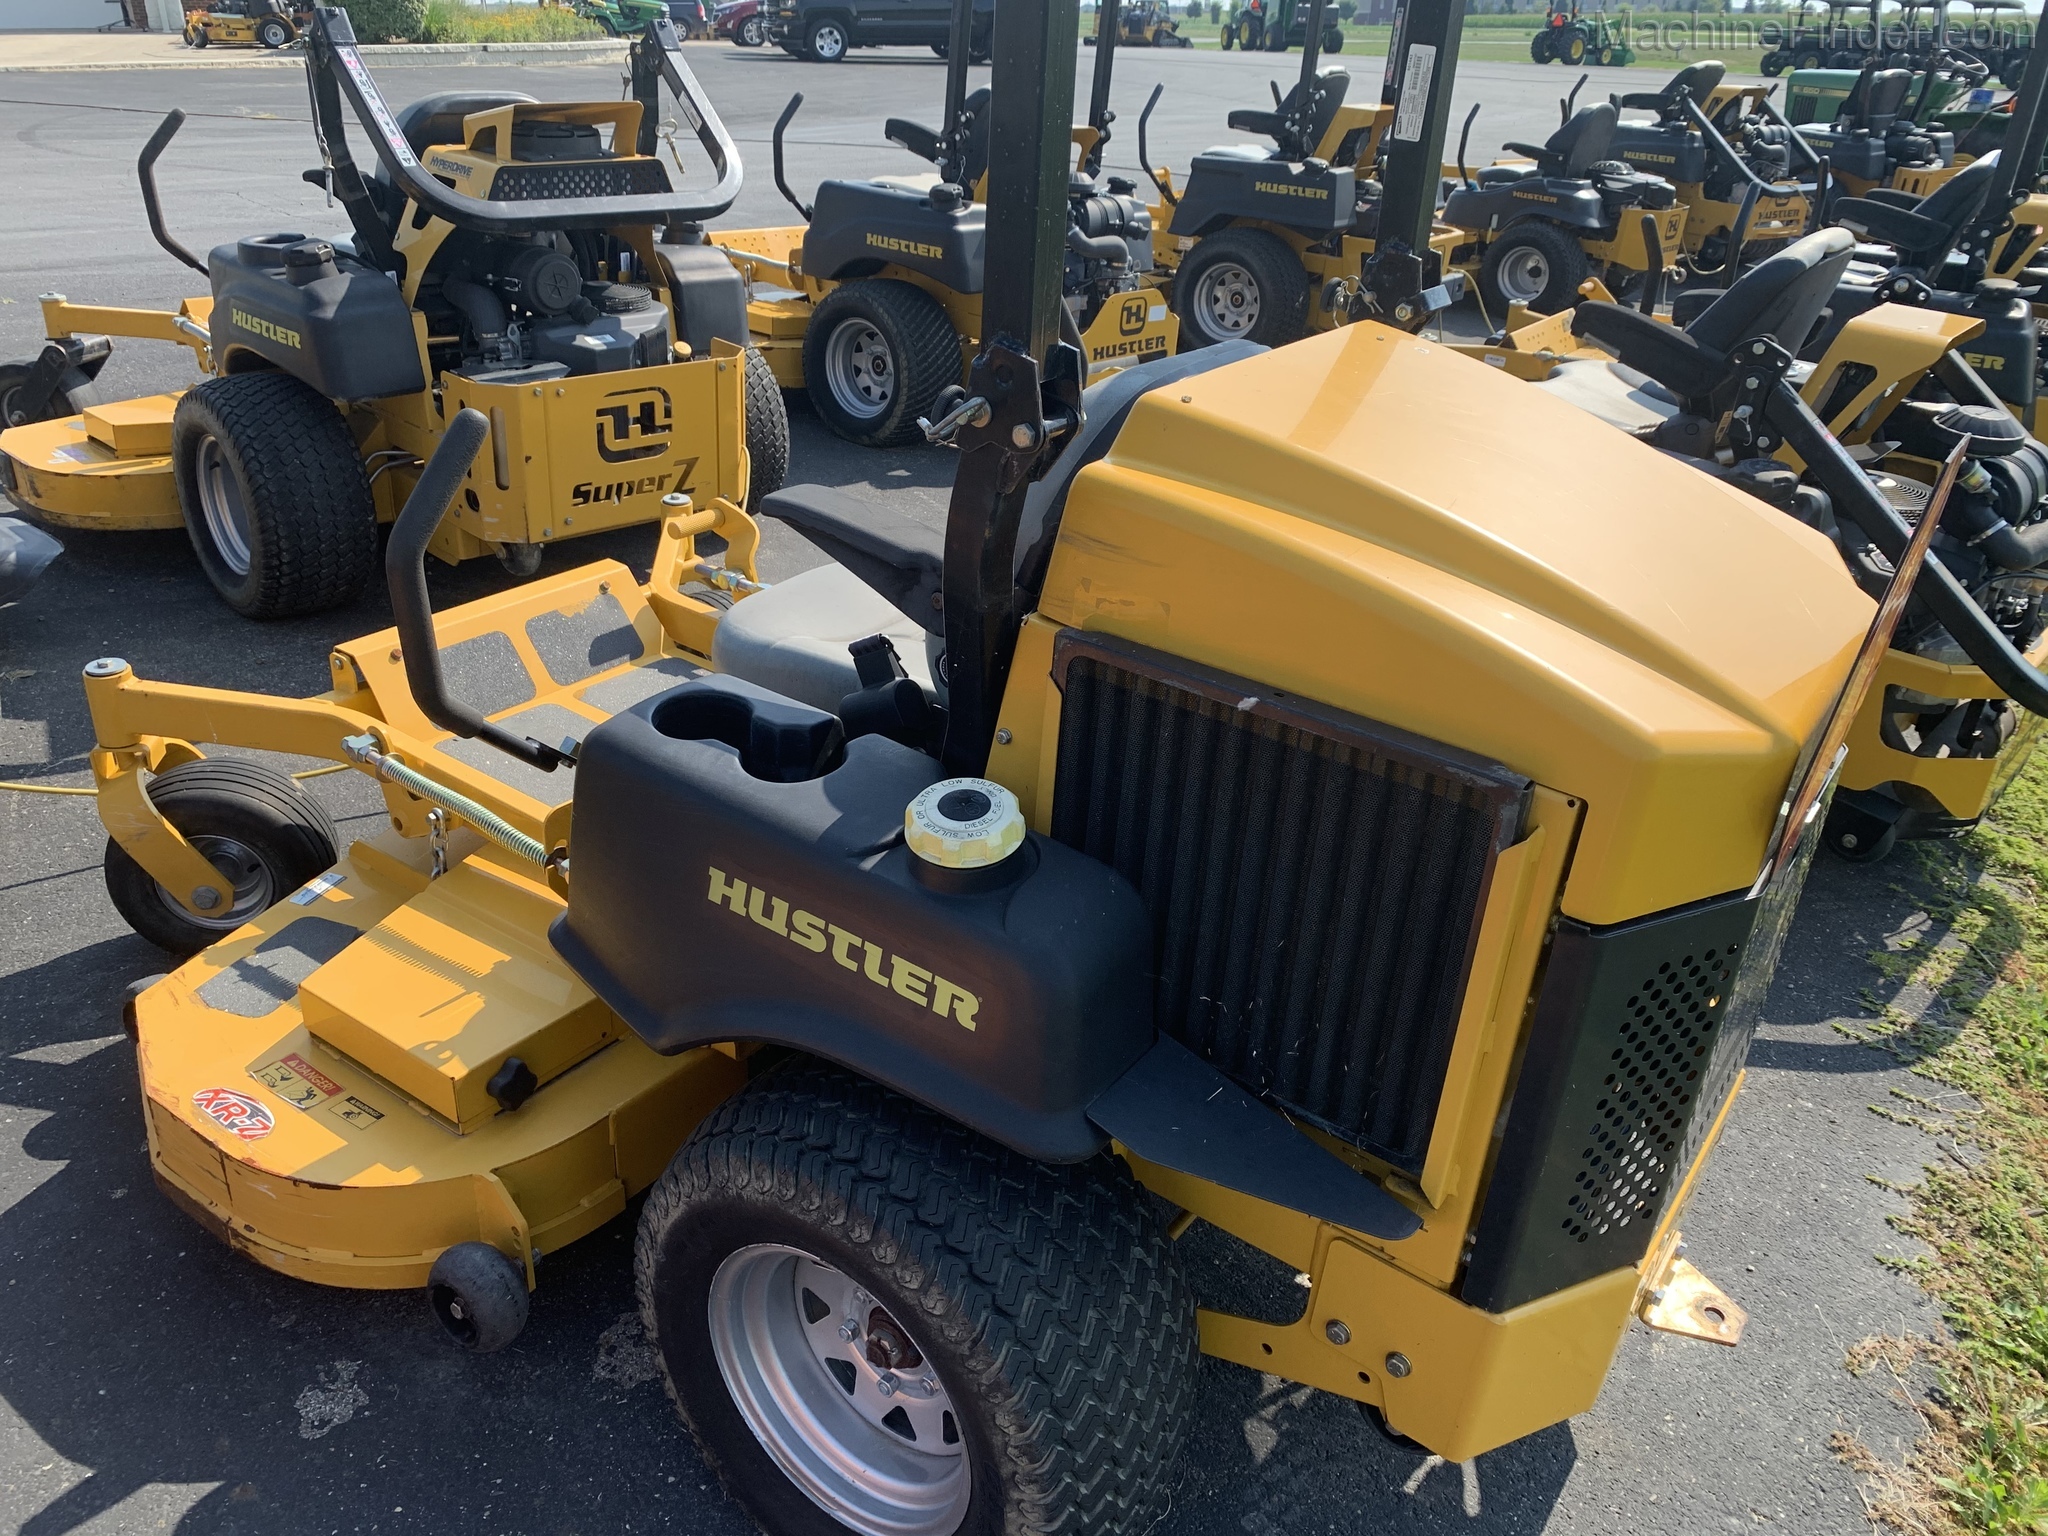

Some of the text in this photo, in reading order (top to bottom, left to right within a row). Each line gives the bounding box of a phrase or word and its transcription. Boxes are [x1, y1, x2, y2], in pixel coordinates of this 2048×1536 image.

[1623, 151, 1676, 164] HUSTLER
[1254, 181, 1329, 200] HUSTLER
[1512, 190, 1558, 203] HUSTLER
[866, 232, 943, 259] HUSTLER
[232, 308, 302, 349] HUSTLER
[1092, 335, 1166, 361] HUSTLER
[915, 779, 1005, 839] LOW SULFUR OR ULTRA LOW SULFUR
[964, 817, 994, 830] DIESEL
[707, 866, 980, 1032] HUSTLER
[294, 1062, 337, 1093] DANGER!
